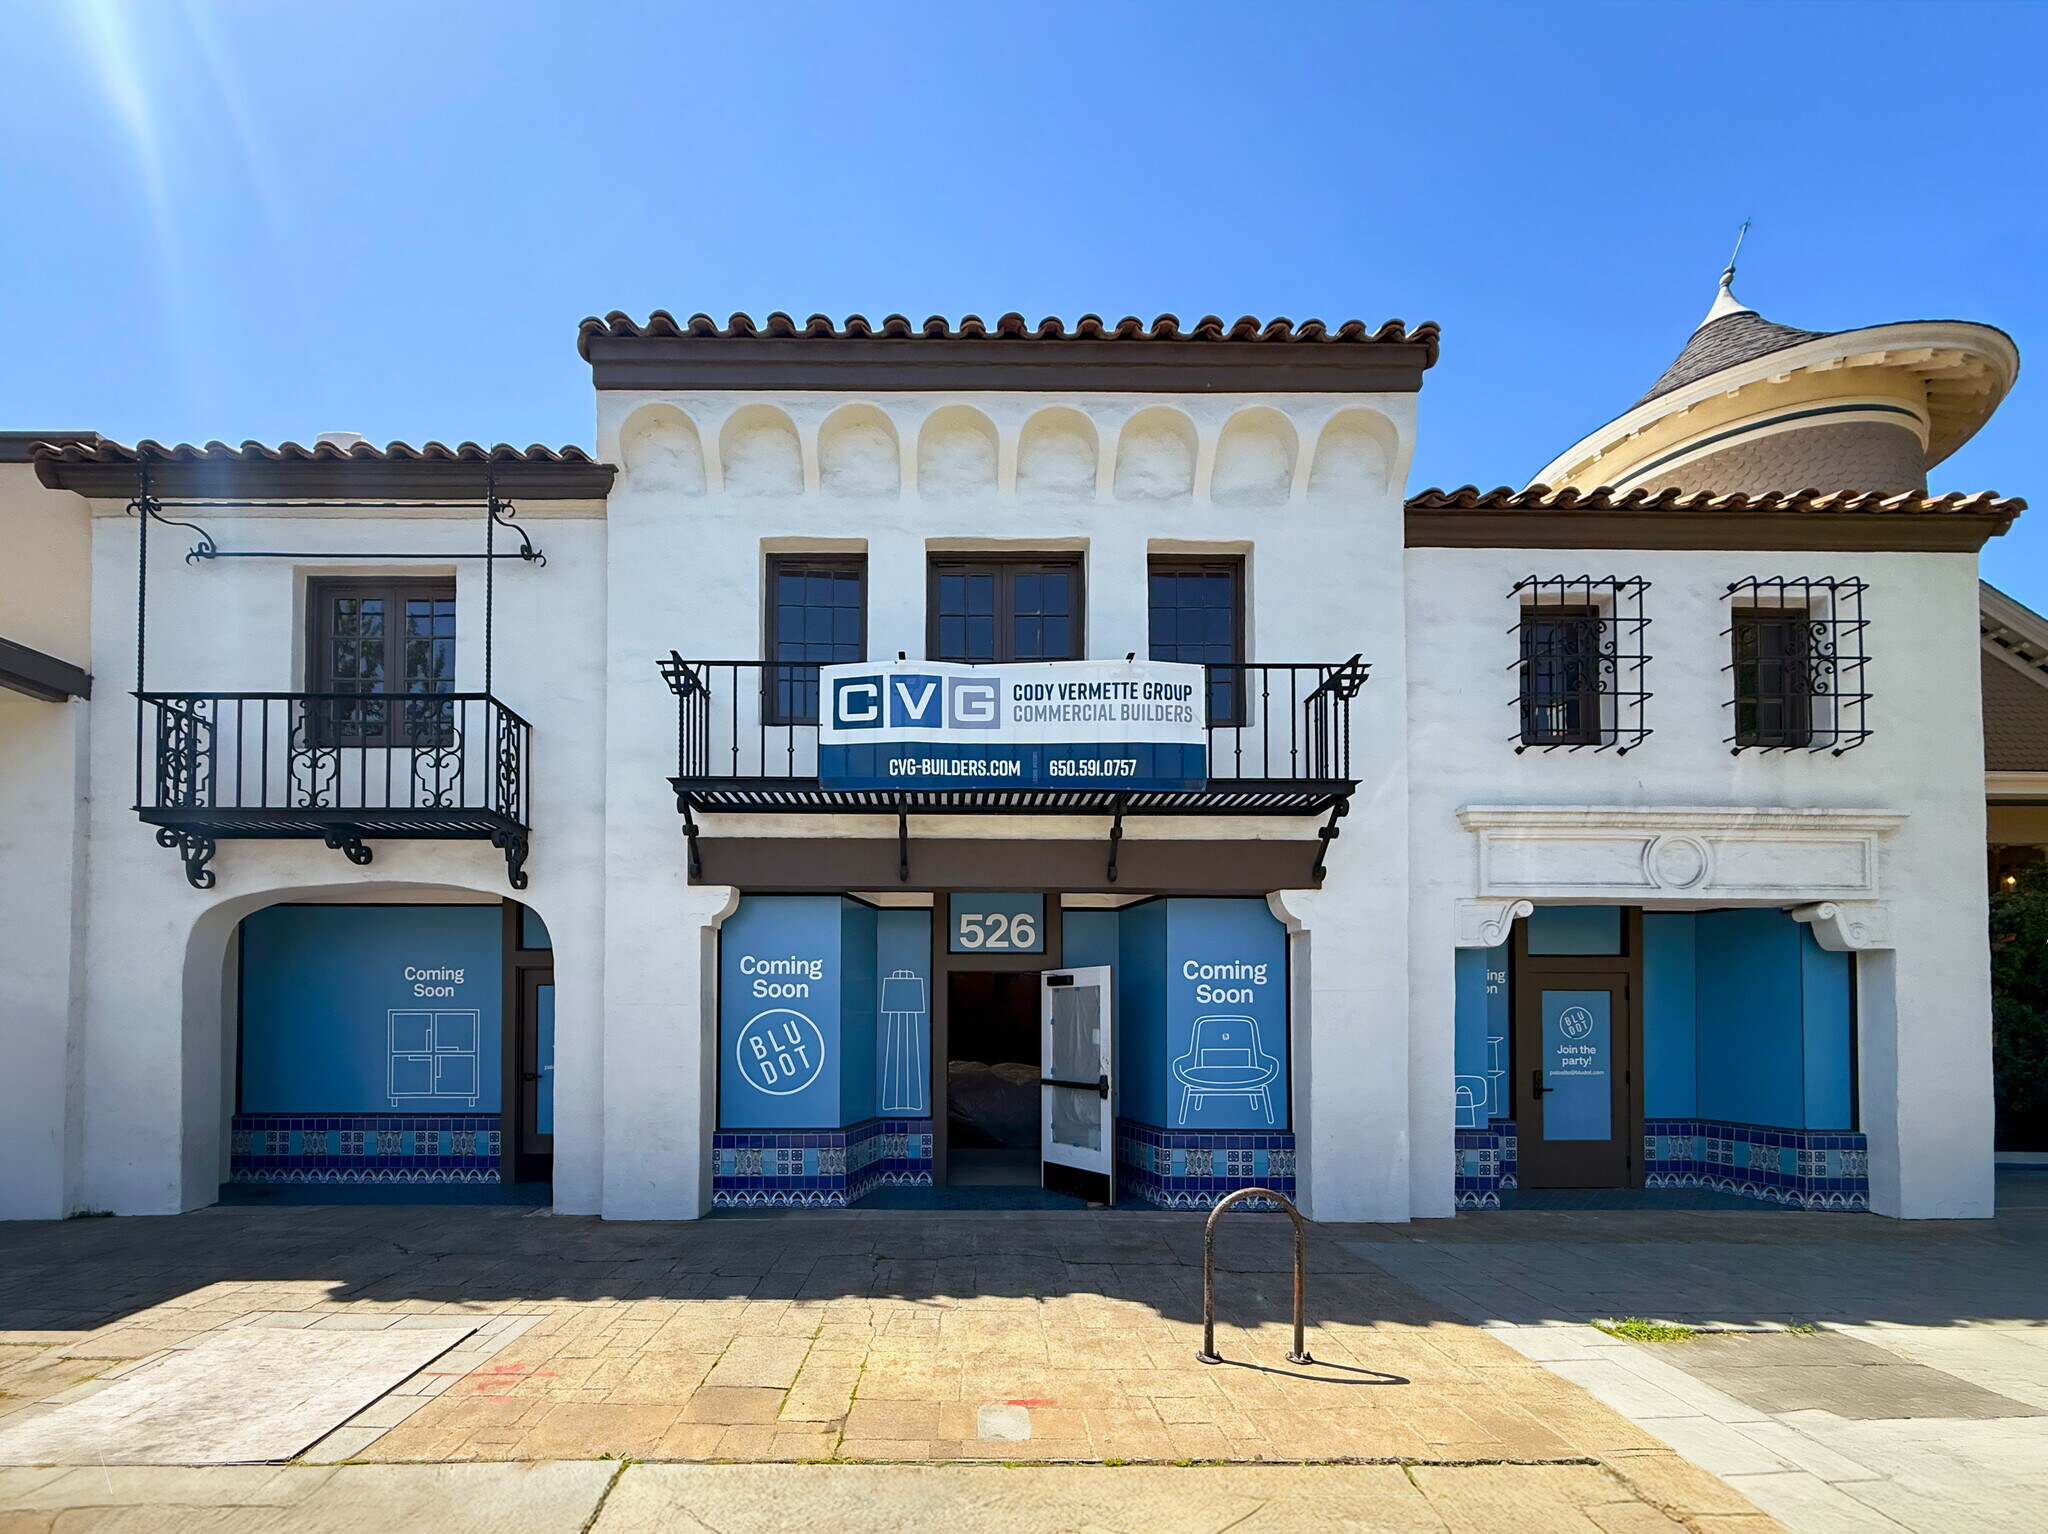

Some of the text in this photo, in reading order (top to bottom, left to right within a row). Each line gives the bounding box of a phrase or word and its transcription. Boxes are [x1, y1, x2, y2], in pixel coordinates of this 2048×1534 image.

[1013, 681, 1192, 702] CODY VERMETTE GROUP
[838, 682, 995, 722] CVG
[1013, 703, 1193, 723] COMMERCIAL BUILDERS
[889, 758, 1020, 776] CVG-BUILDERS.COM
[1049, 759, 1137, 776] 650.591.0757
[959, 912, 1036, 948] 526
[404, 966, 465, 984] Coming
[740, 955, 823, 980] Coming
[1183, 960, 1267, 985] Coming
[1486, 969, 1506, 983] ing
[413, 983, 455, 997] Soon
[752, 979, 809, 998] Soon
[1196, 983, 1254, 1004] Soon
[1564, 1011, 1585, 1026] BLU
[1568, 1020, 1588, 1036] DOT
[749, 1020, 801, 1060] BLU
[1556, 1045, 1597, 1054] Join the
[760, 1044, 810, 1085] DOT
[1562, 1056, 1592, 1067] party!
